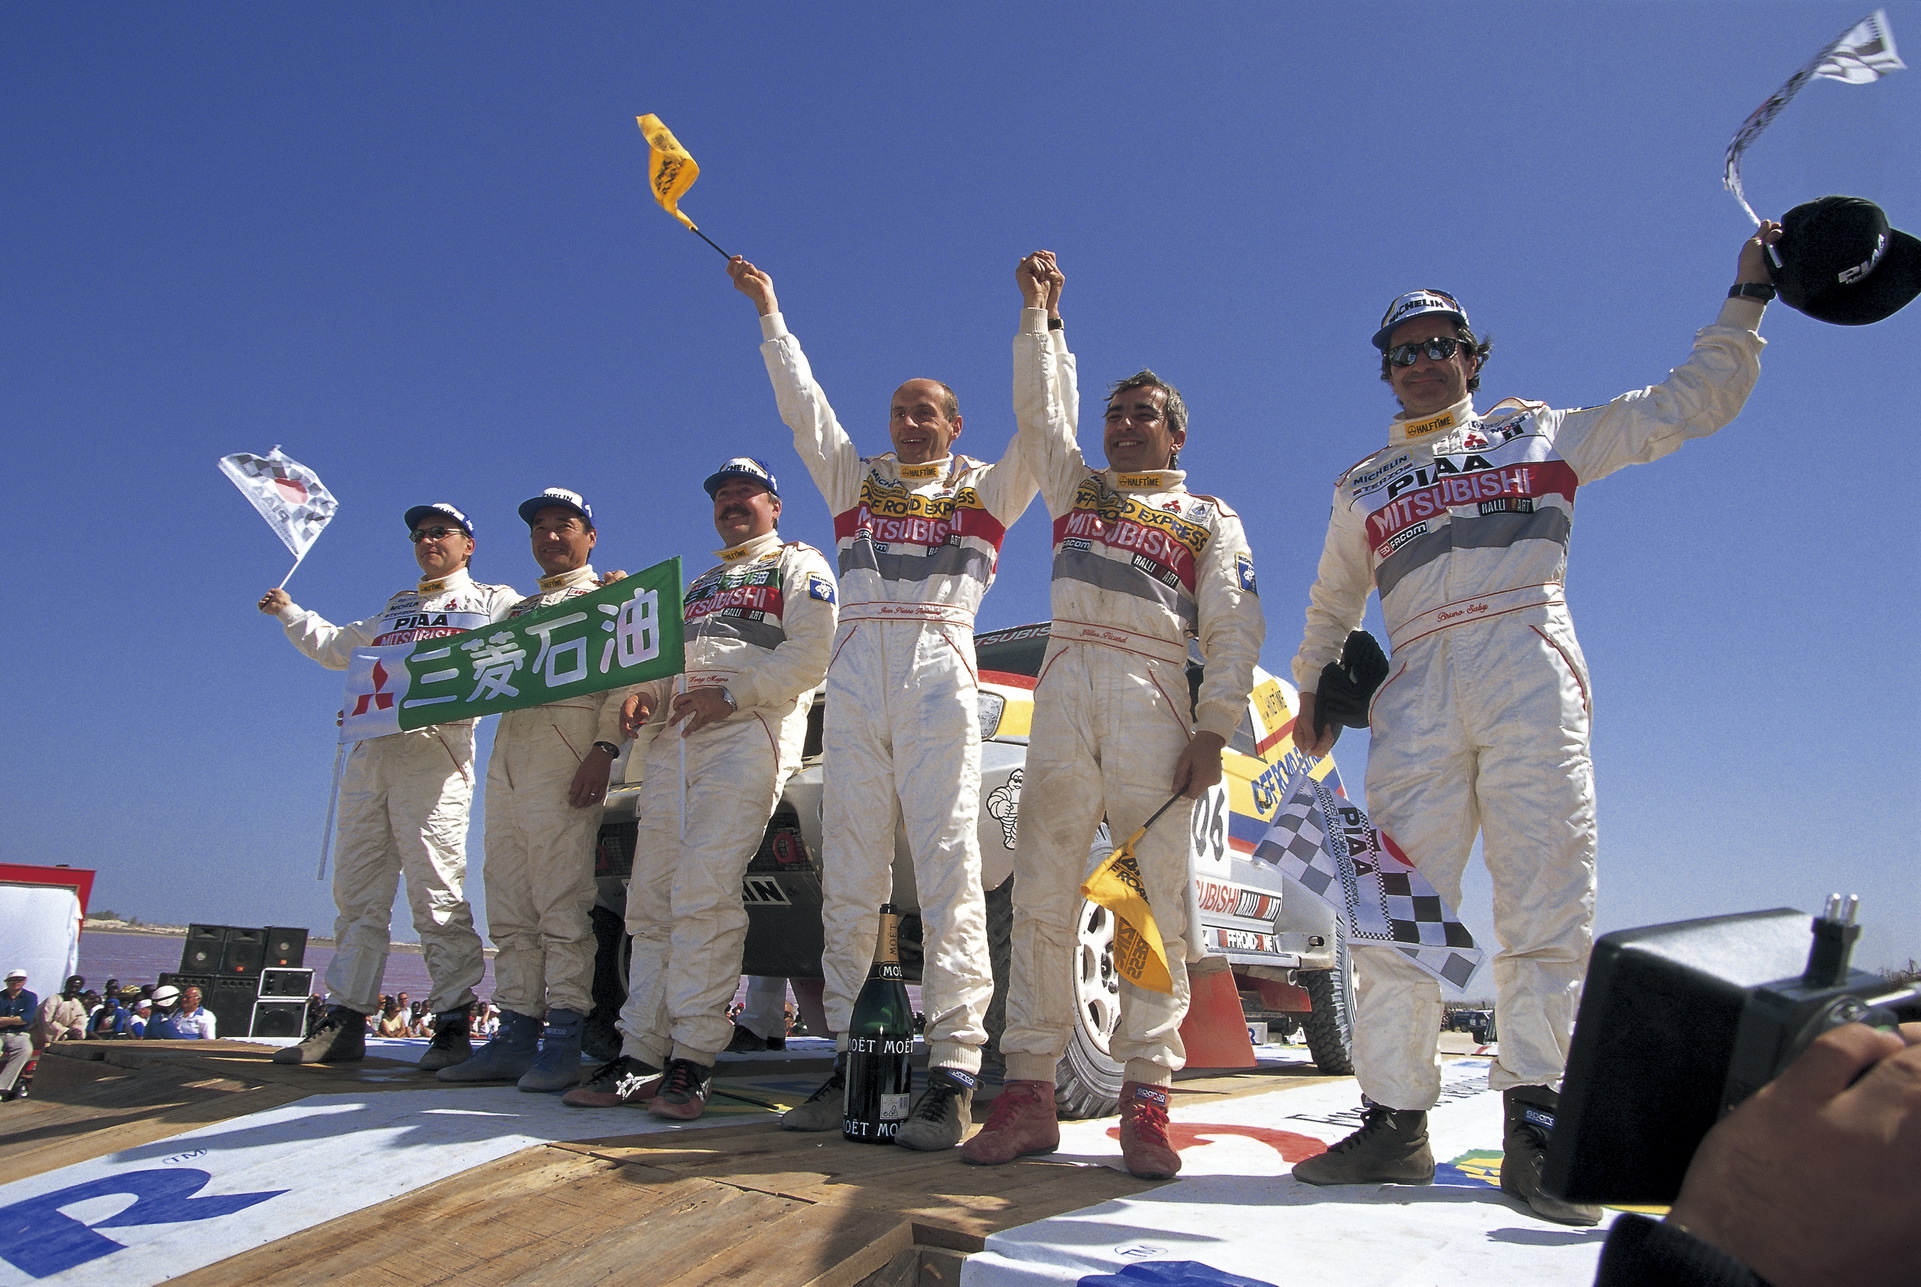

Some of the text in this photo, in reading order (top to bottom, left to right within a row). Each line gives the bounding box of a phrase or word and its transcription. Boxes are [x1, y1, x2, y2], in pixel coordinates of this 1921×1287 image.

[1416, 416, 1452, 435] HALFTIME
[909, 467, 937, 477] HALFTIME
[1127, 477, 1159, 486] HALFTIME
[1353, 455, 1408, 486] MICHELIN
[1361, 469, 1403, 491] TERZO
[1387, 455, 1495, 501] PIAA
[1371, 469, 1530, 537] MITSUBISHI
[1481, 499, 1531, 514] RALLI ART
[1138, 511, 1208, 552] EXPRESS
[1133, 556, 1178, 585] RALLI ART
[393, 614, 449, 631] PIAA
[723, 608, 763, 621] RALLI ART
[1436, 603, 1488, 622] Bruno Saby
[1103, 632, 1128, 643] Picard
[402, 588, 660, 710] 三菱石油
[1322, 787, 1339, 817] PRODUCED
[1348, 878, 1361, 907] DESIGN
[1338, 806, 1374, 877] PIAA
